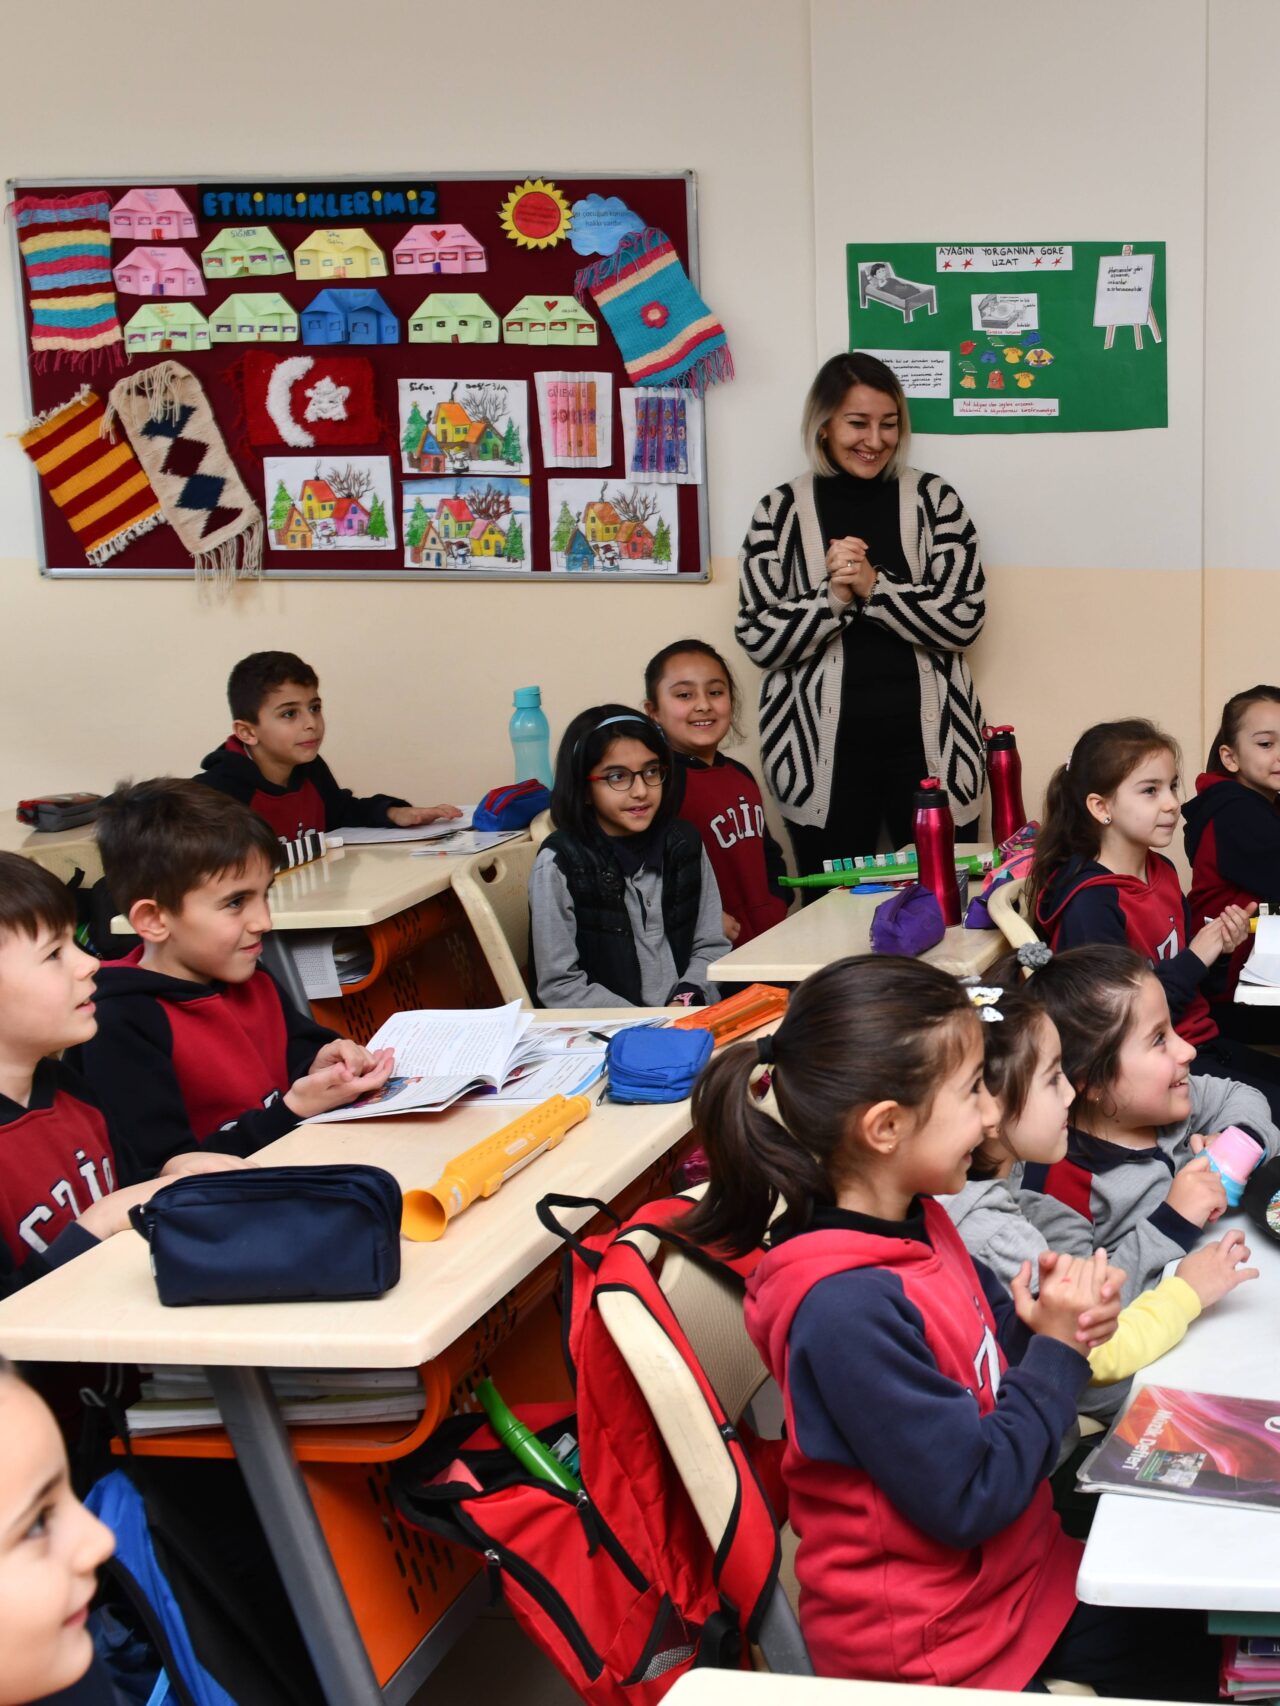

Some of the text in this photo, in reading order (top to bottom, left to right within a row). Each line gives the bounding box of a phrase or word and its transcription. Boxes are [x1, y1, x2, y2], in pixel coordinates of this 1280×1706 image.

[203, 190, 436, 217] ETKİNLİKLERİMİZ
[982, 247, 1035, 256] YORGANINA
[992, 258, 1019, 266] UZAT
